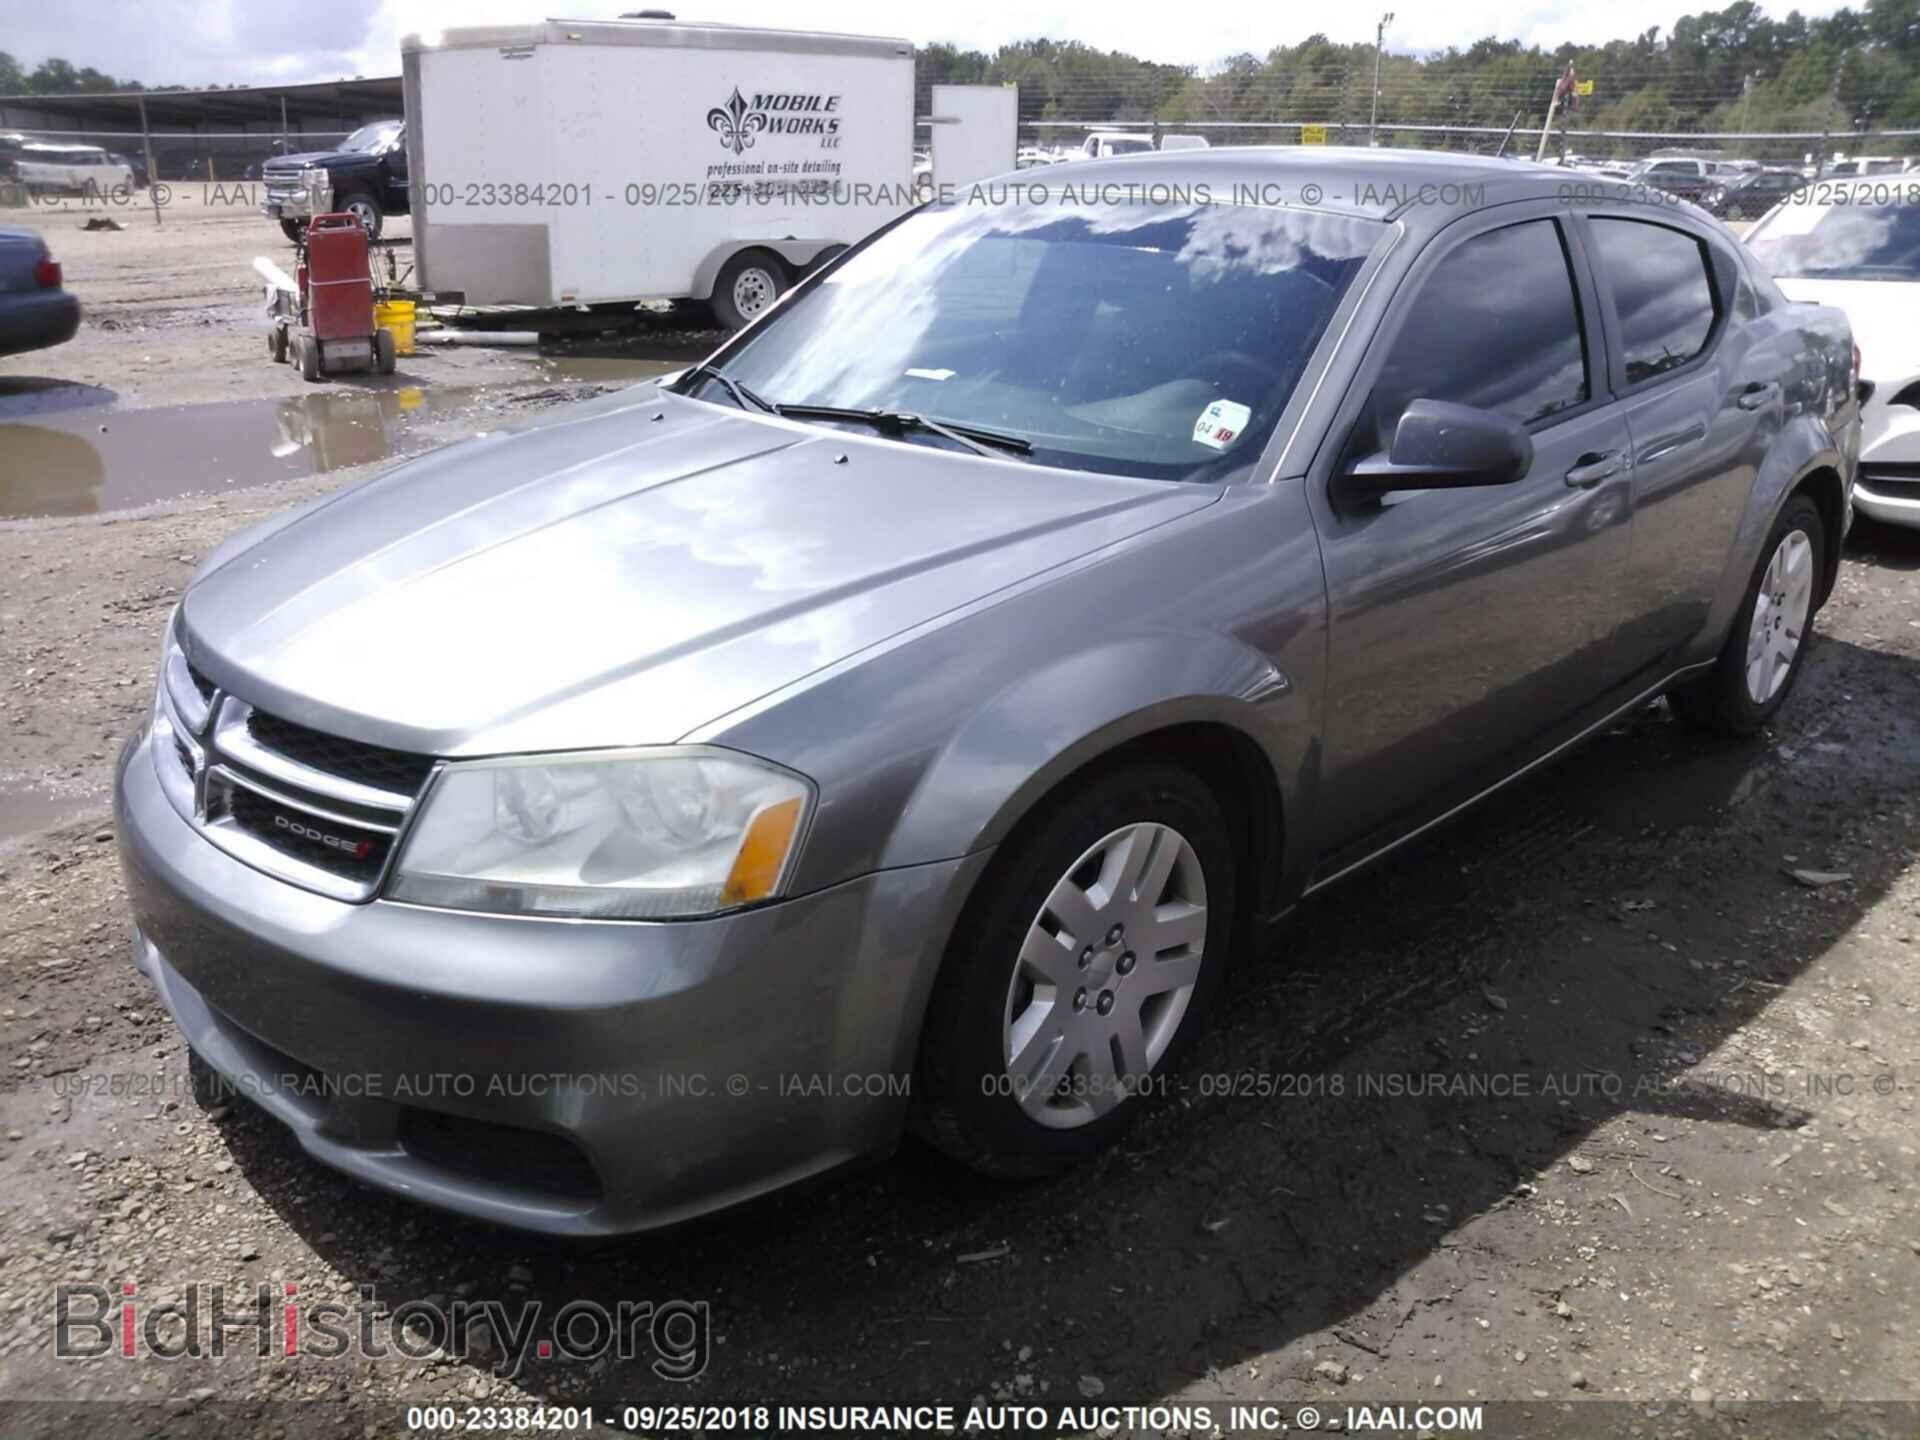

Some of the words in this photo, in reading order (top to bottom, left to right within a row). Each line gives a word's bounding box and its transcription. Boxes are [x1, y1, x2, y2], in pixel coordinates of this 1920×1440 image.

[751, 94, 841, 112] MOBILE
[768, 118, 841, 134] WORKS
[707, 160, 765, 179] professional
[767, 161, 799, 174] on-site
[801, 159, 841, 176] detailing
[275, 815, 359, 854] DODGE
